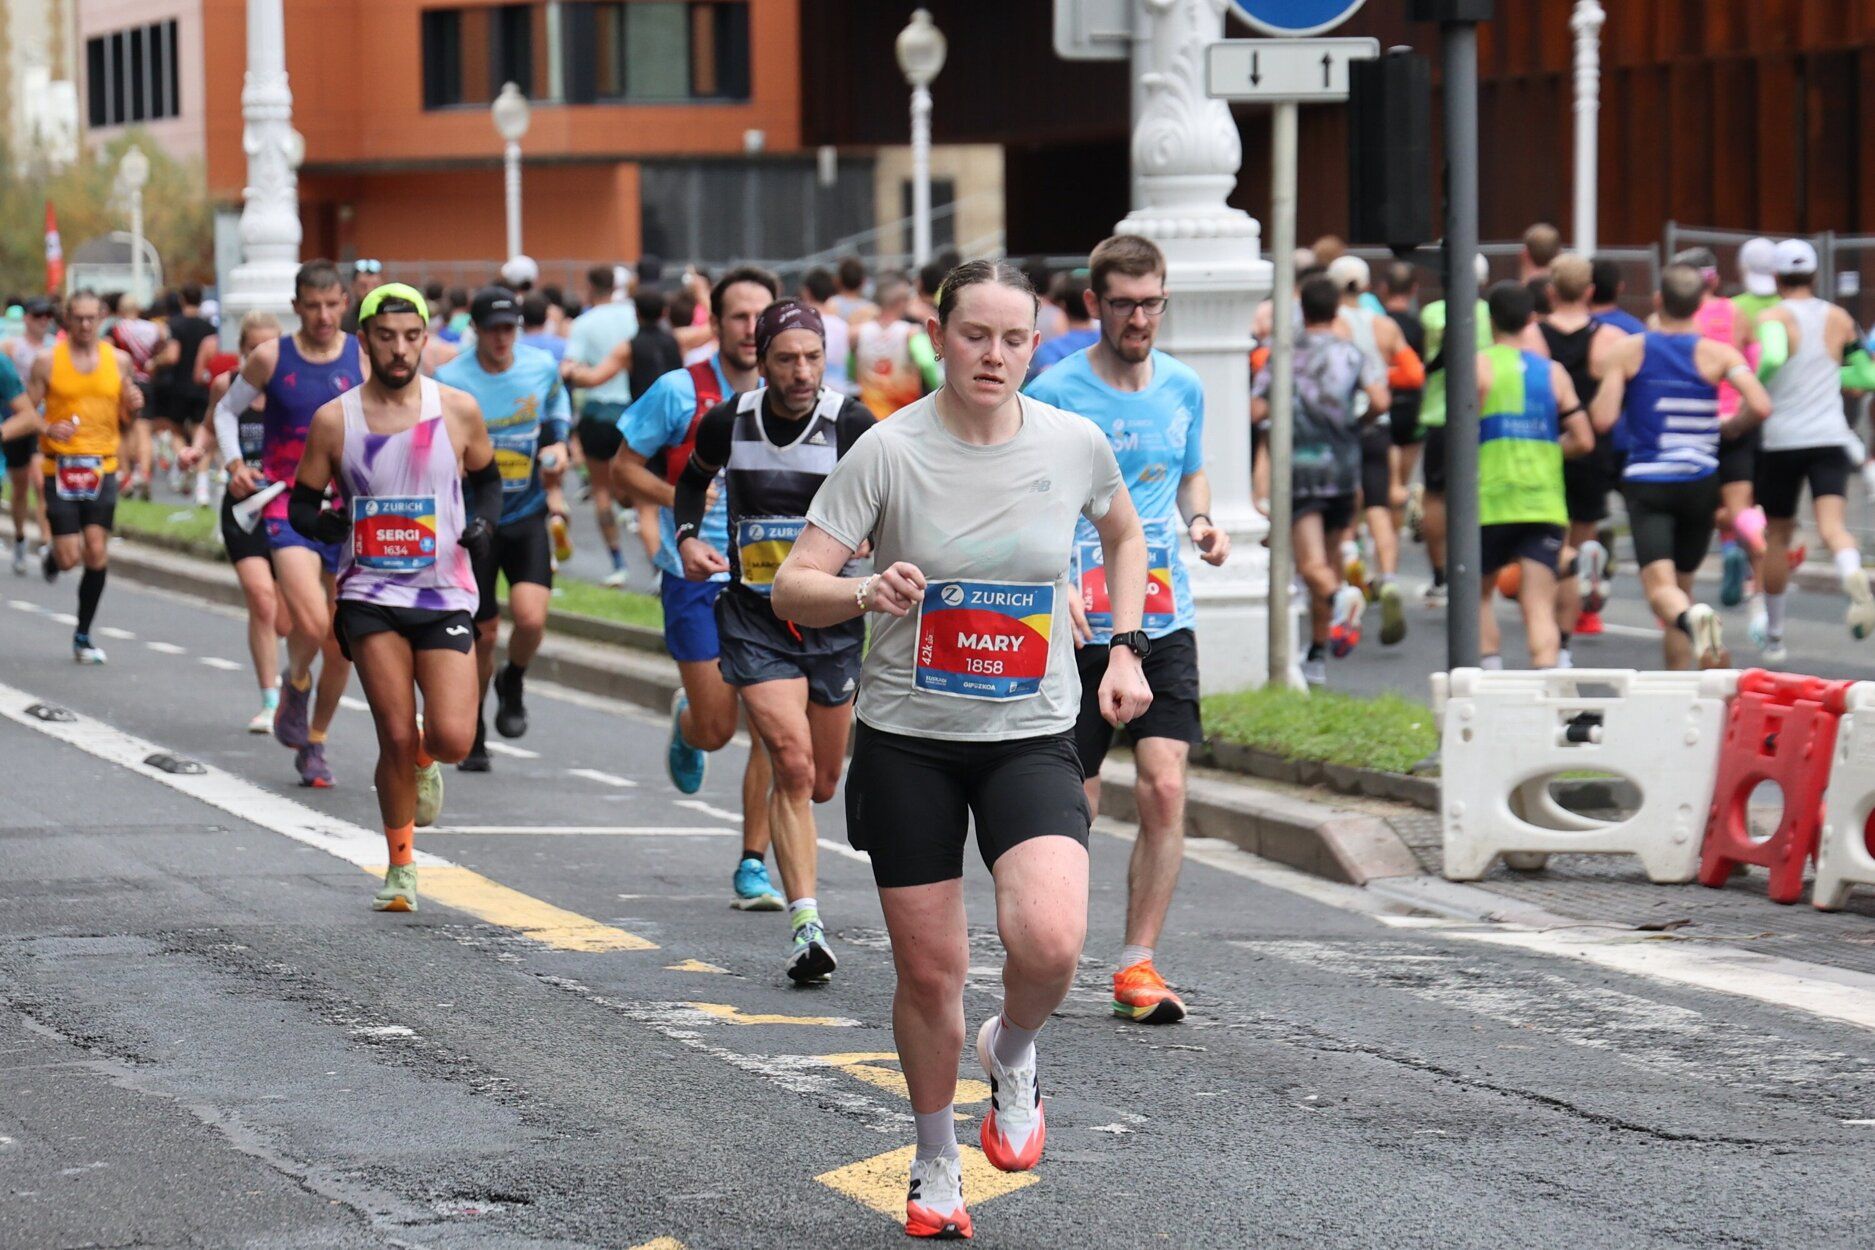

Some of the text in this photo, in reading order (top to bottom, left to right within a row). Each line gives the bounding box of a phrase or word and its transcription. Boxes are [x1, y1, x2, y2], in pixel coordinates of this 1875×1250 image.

[382, 502, 423, 512] ZURICH
[376, 529, 420, 541] SERGI
[384, 545, 408, 555] 1634
[971, 591, 1033, 606] ZURICH
[957, 632, 1025, 652] MARY
[966, 658, 1003, 674] 1858
